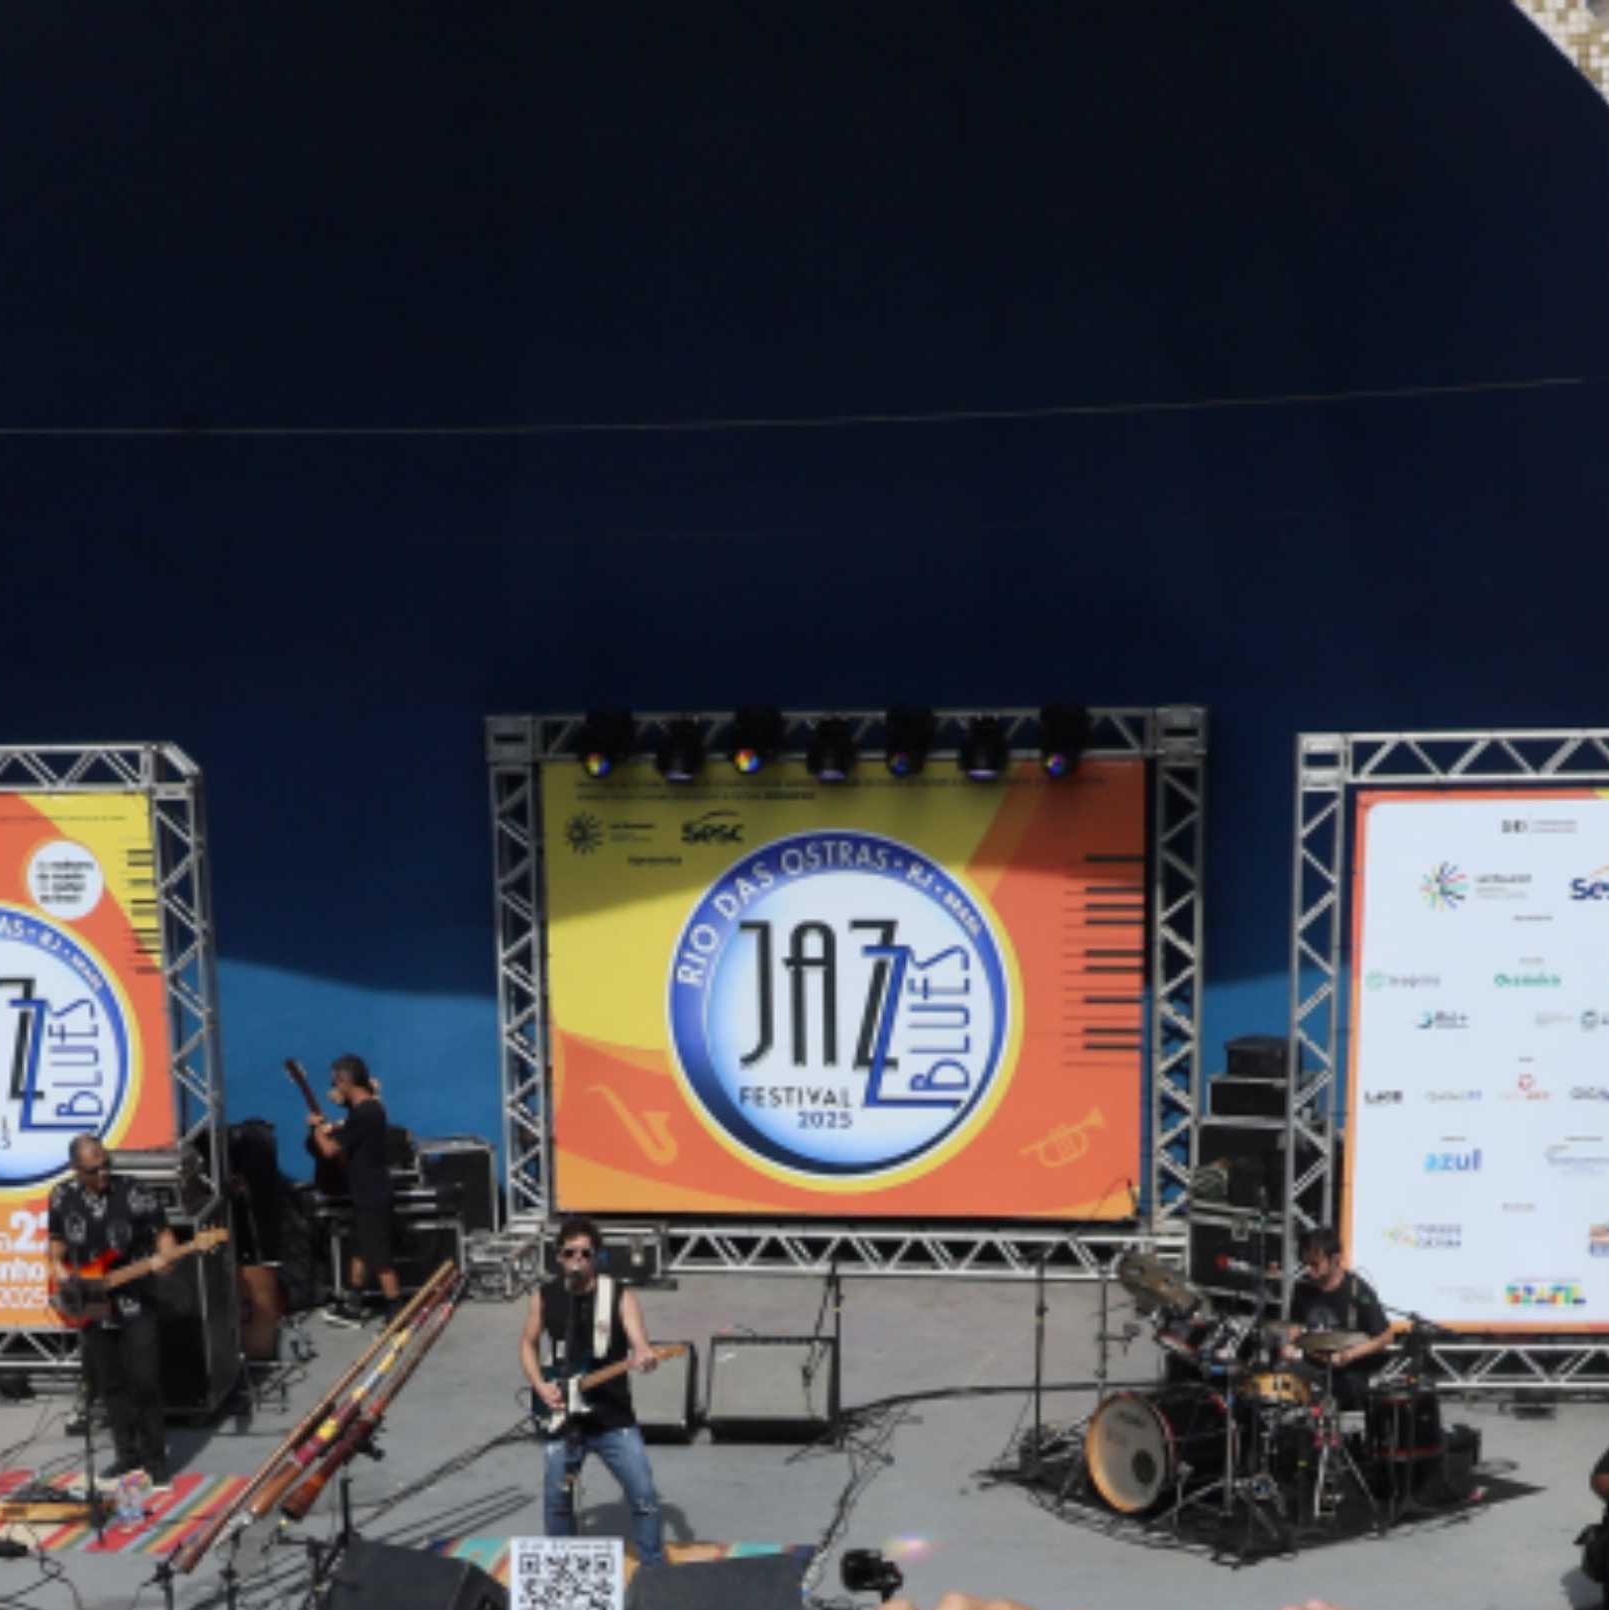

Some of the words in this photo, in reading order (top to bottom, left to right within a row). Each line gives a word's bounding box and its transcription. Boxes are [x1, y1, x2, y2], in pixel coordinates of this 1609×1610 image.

[677, 923, 719, 986] RIO
[713, 861, 775, 919] DAS
[780, 840, 888, 875] OSTRAS
[740, 918, 966, 1108] JAZZ
[907, 943, 972, 1093] BLUES
[740, 1086, 854, 1109] FESTIVAL
[797, 1110, 854, 1130] 2025
[1423, 1148, 1483, 1173] azul
